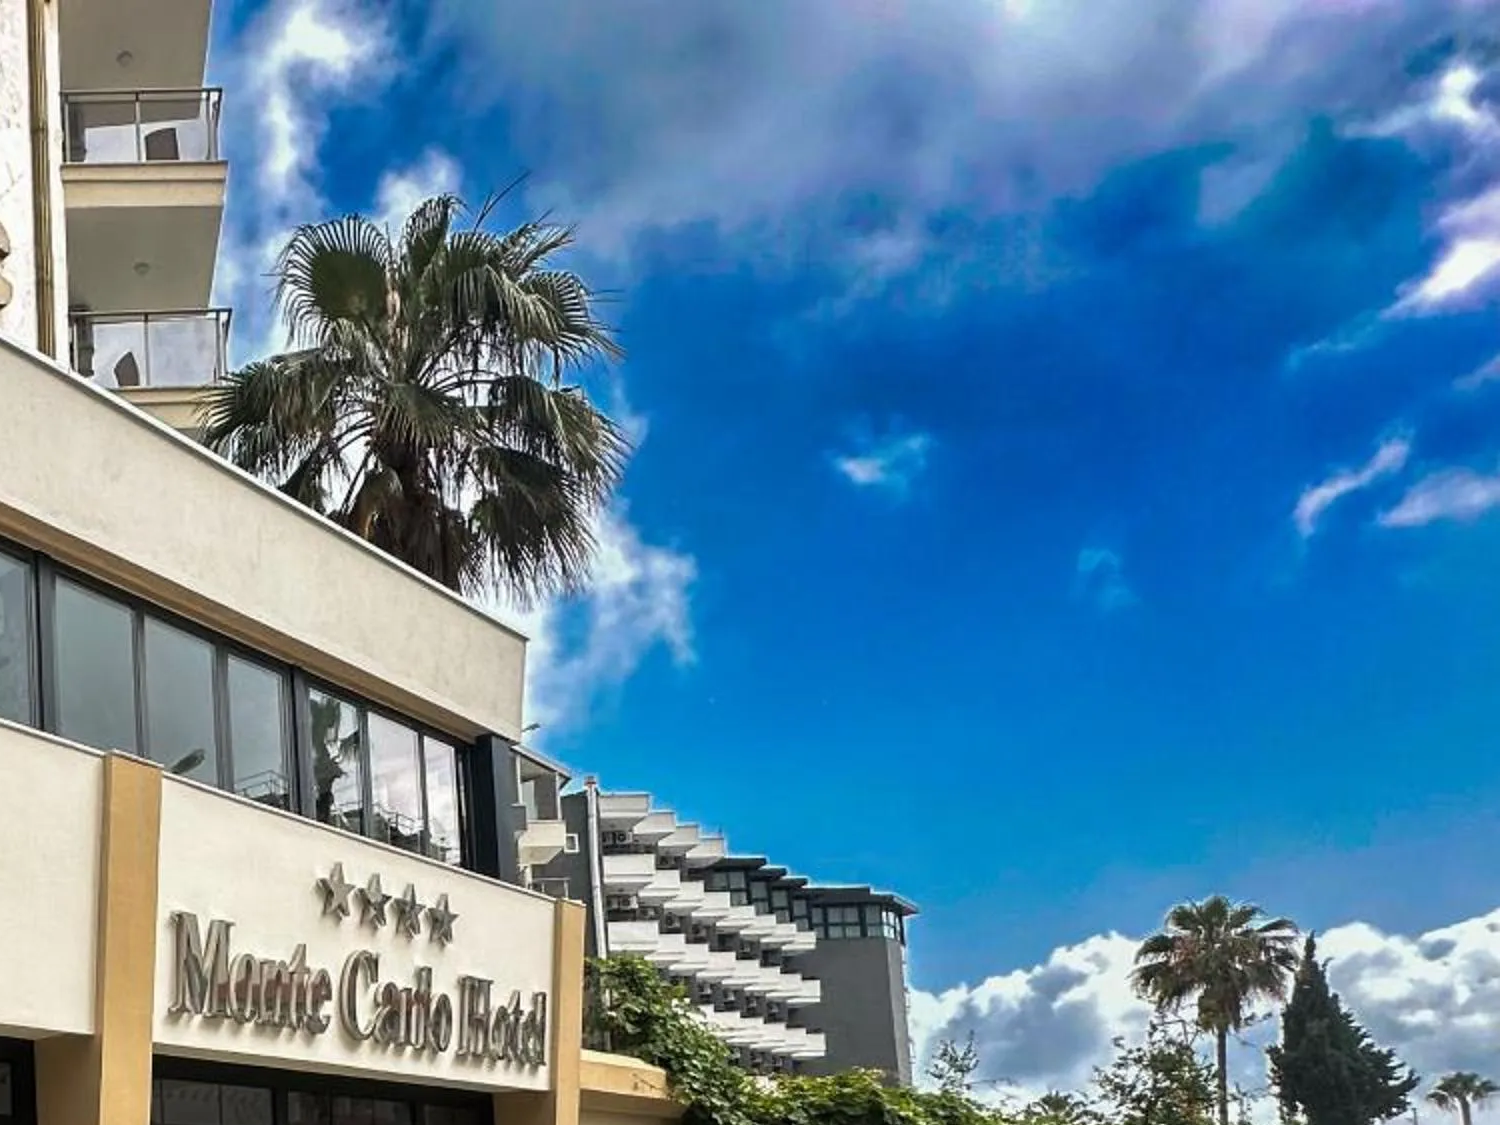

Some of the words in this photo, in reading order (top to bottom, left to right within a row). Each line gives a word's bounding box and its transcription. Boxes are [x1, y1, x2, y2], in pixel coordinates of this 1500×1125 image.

[168, 911, 333, 1035] Monte
[339, 949, 453, 1052] Carlo
[457, 974, 547, 1066] Hotel
